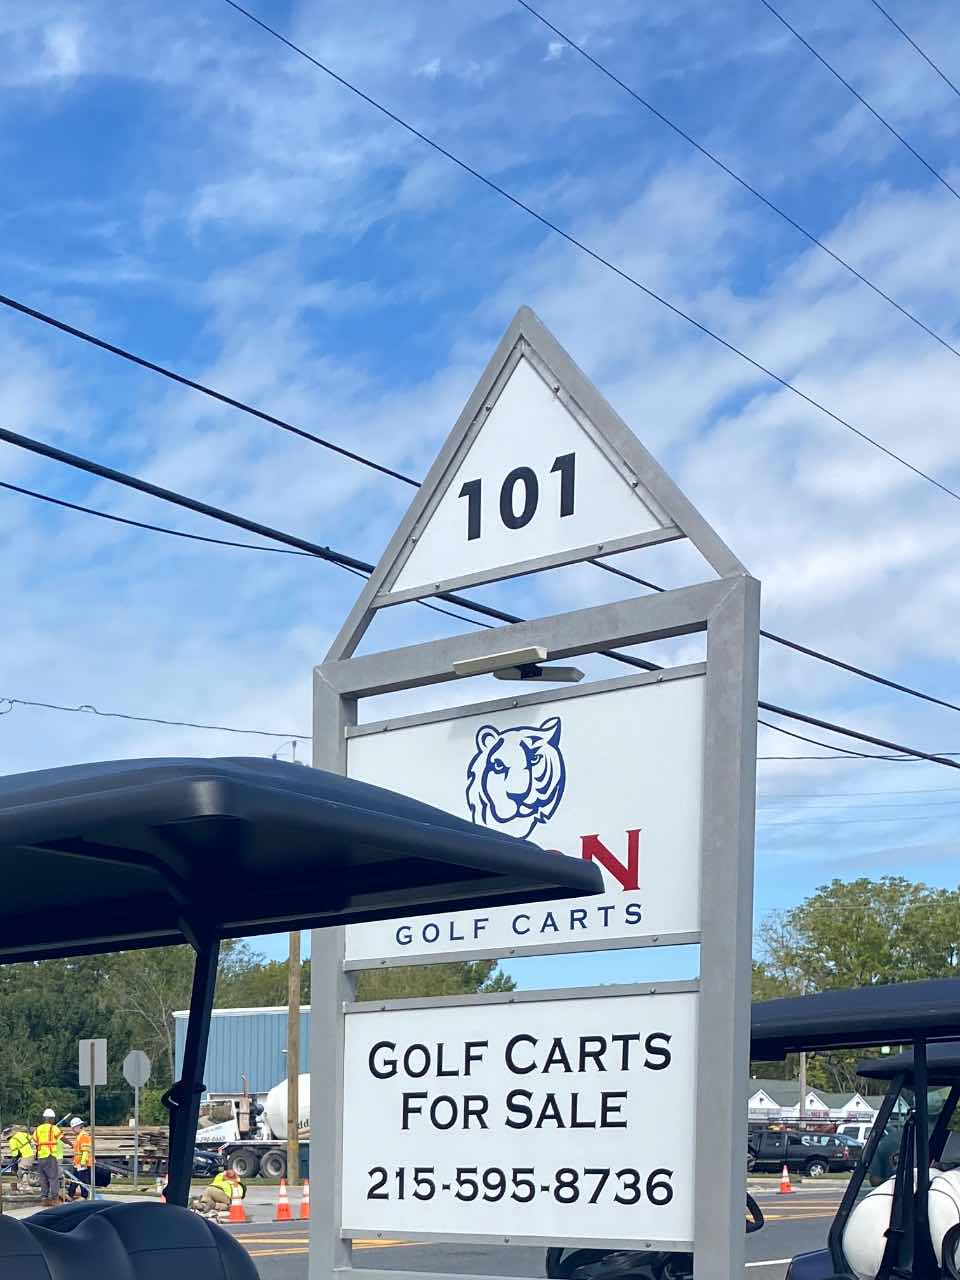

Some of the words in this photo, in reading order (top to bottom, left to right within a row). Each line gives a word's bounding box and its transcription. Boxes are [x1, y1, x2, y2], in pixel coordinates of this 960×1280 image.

[458, 452, 576, 541] 101
[395, 918, 489, 946] GOLF
[512, 903, 643, 936] CARTS
[368, 1039, 489, 1079] GOLF
[504, 1032, 672, 1075] CARTS
[401, 1091, 490, 1130] FOR
[504, 1088, 628, 1130] SALE
[366, 1166, 674, 1206] 215-595-8736
